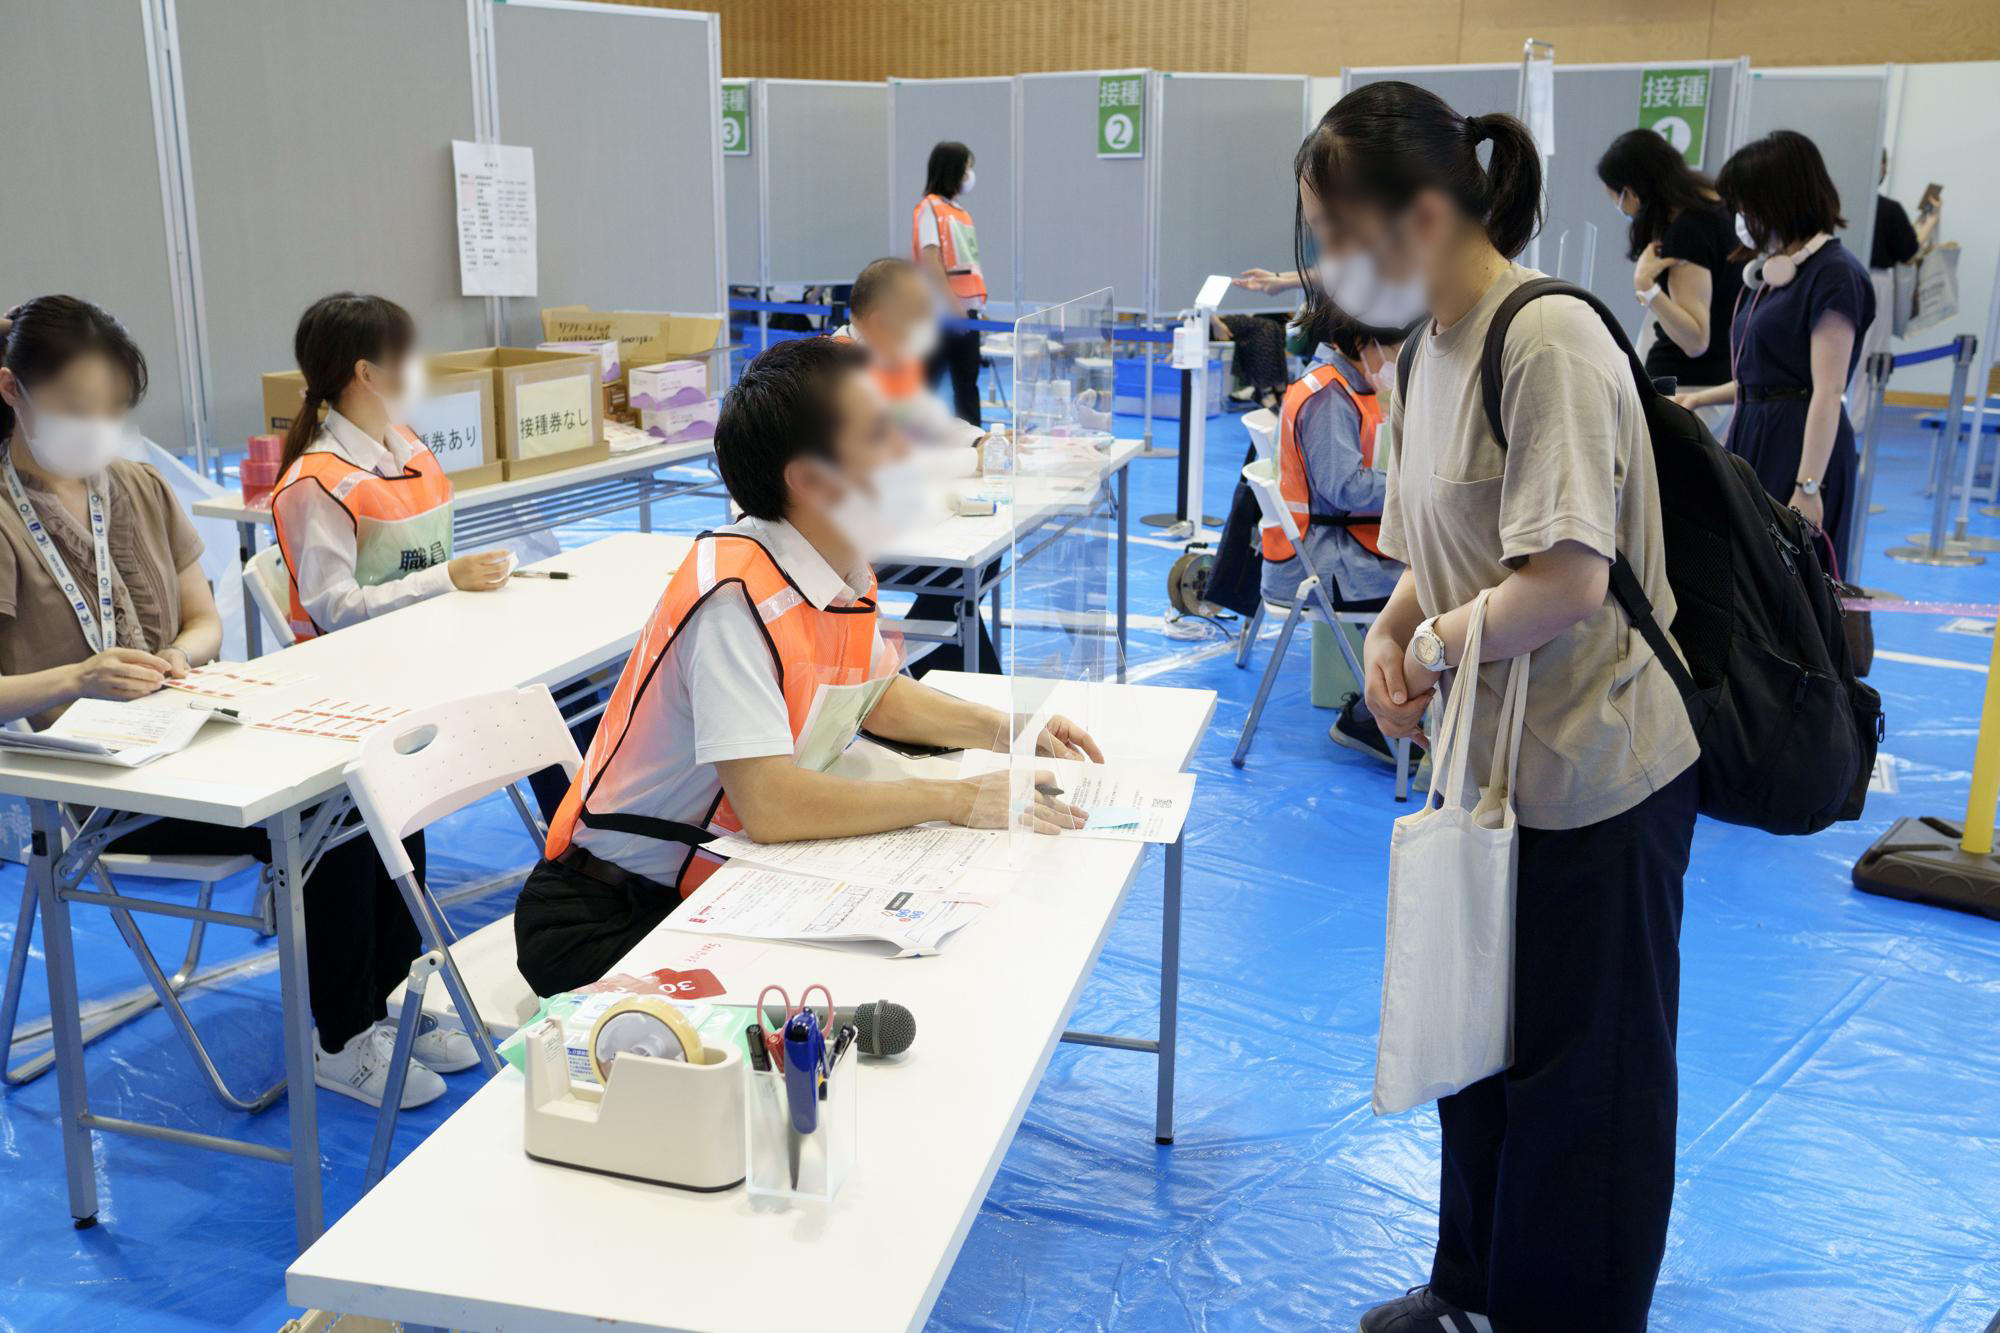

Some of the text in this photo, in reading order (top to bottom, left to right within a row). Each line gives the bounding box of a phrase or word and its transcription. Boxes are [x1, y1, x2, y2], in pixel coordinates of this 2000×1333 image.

[1100, 80, 1140, 107] 接種
[1642, 75, 1705, 108] 接種
[723, 123, 735, 144] 3
[1112, 120, 1126, 144] 2
[520, 408, 589, 440] 接種券なし
[399, 541, 446, 571] 職員
[658, 980, 696, 994] 30
